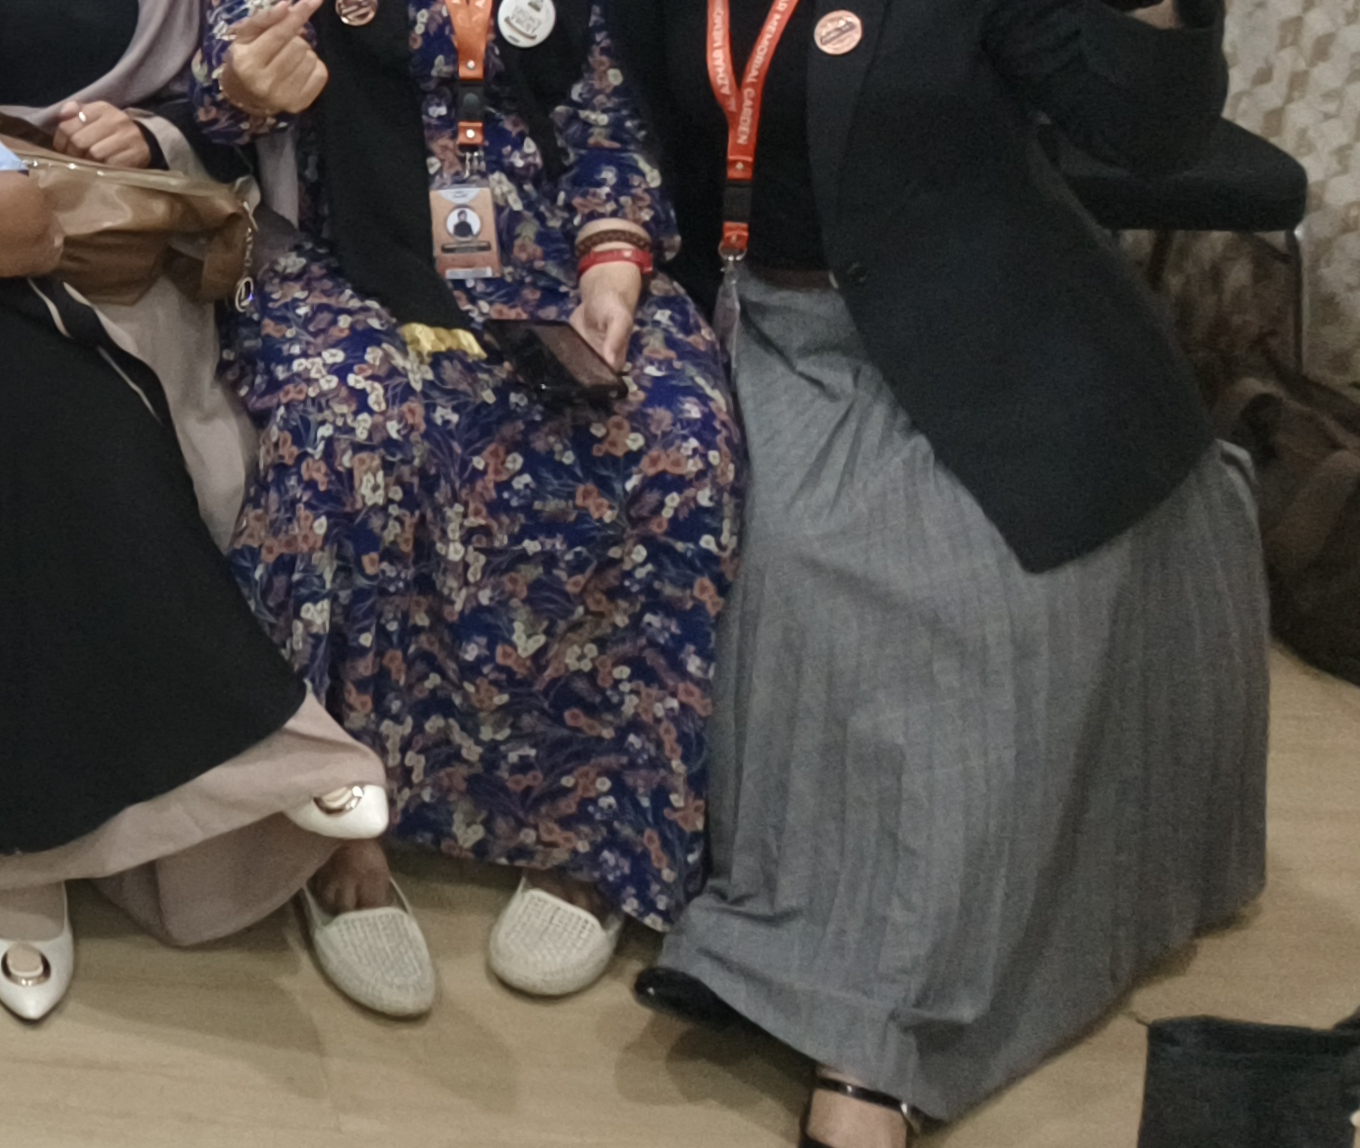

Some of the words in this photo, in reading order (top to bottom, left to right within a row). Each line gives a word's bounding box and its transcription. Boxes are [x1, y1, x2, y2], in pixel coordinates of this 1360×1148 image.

[712, 49, 733, 96] AZHAR
[746, 12, 783, 84] MEMORIAL
[736, 87, 757, 146] GARDEN
